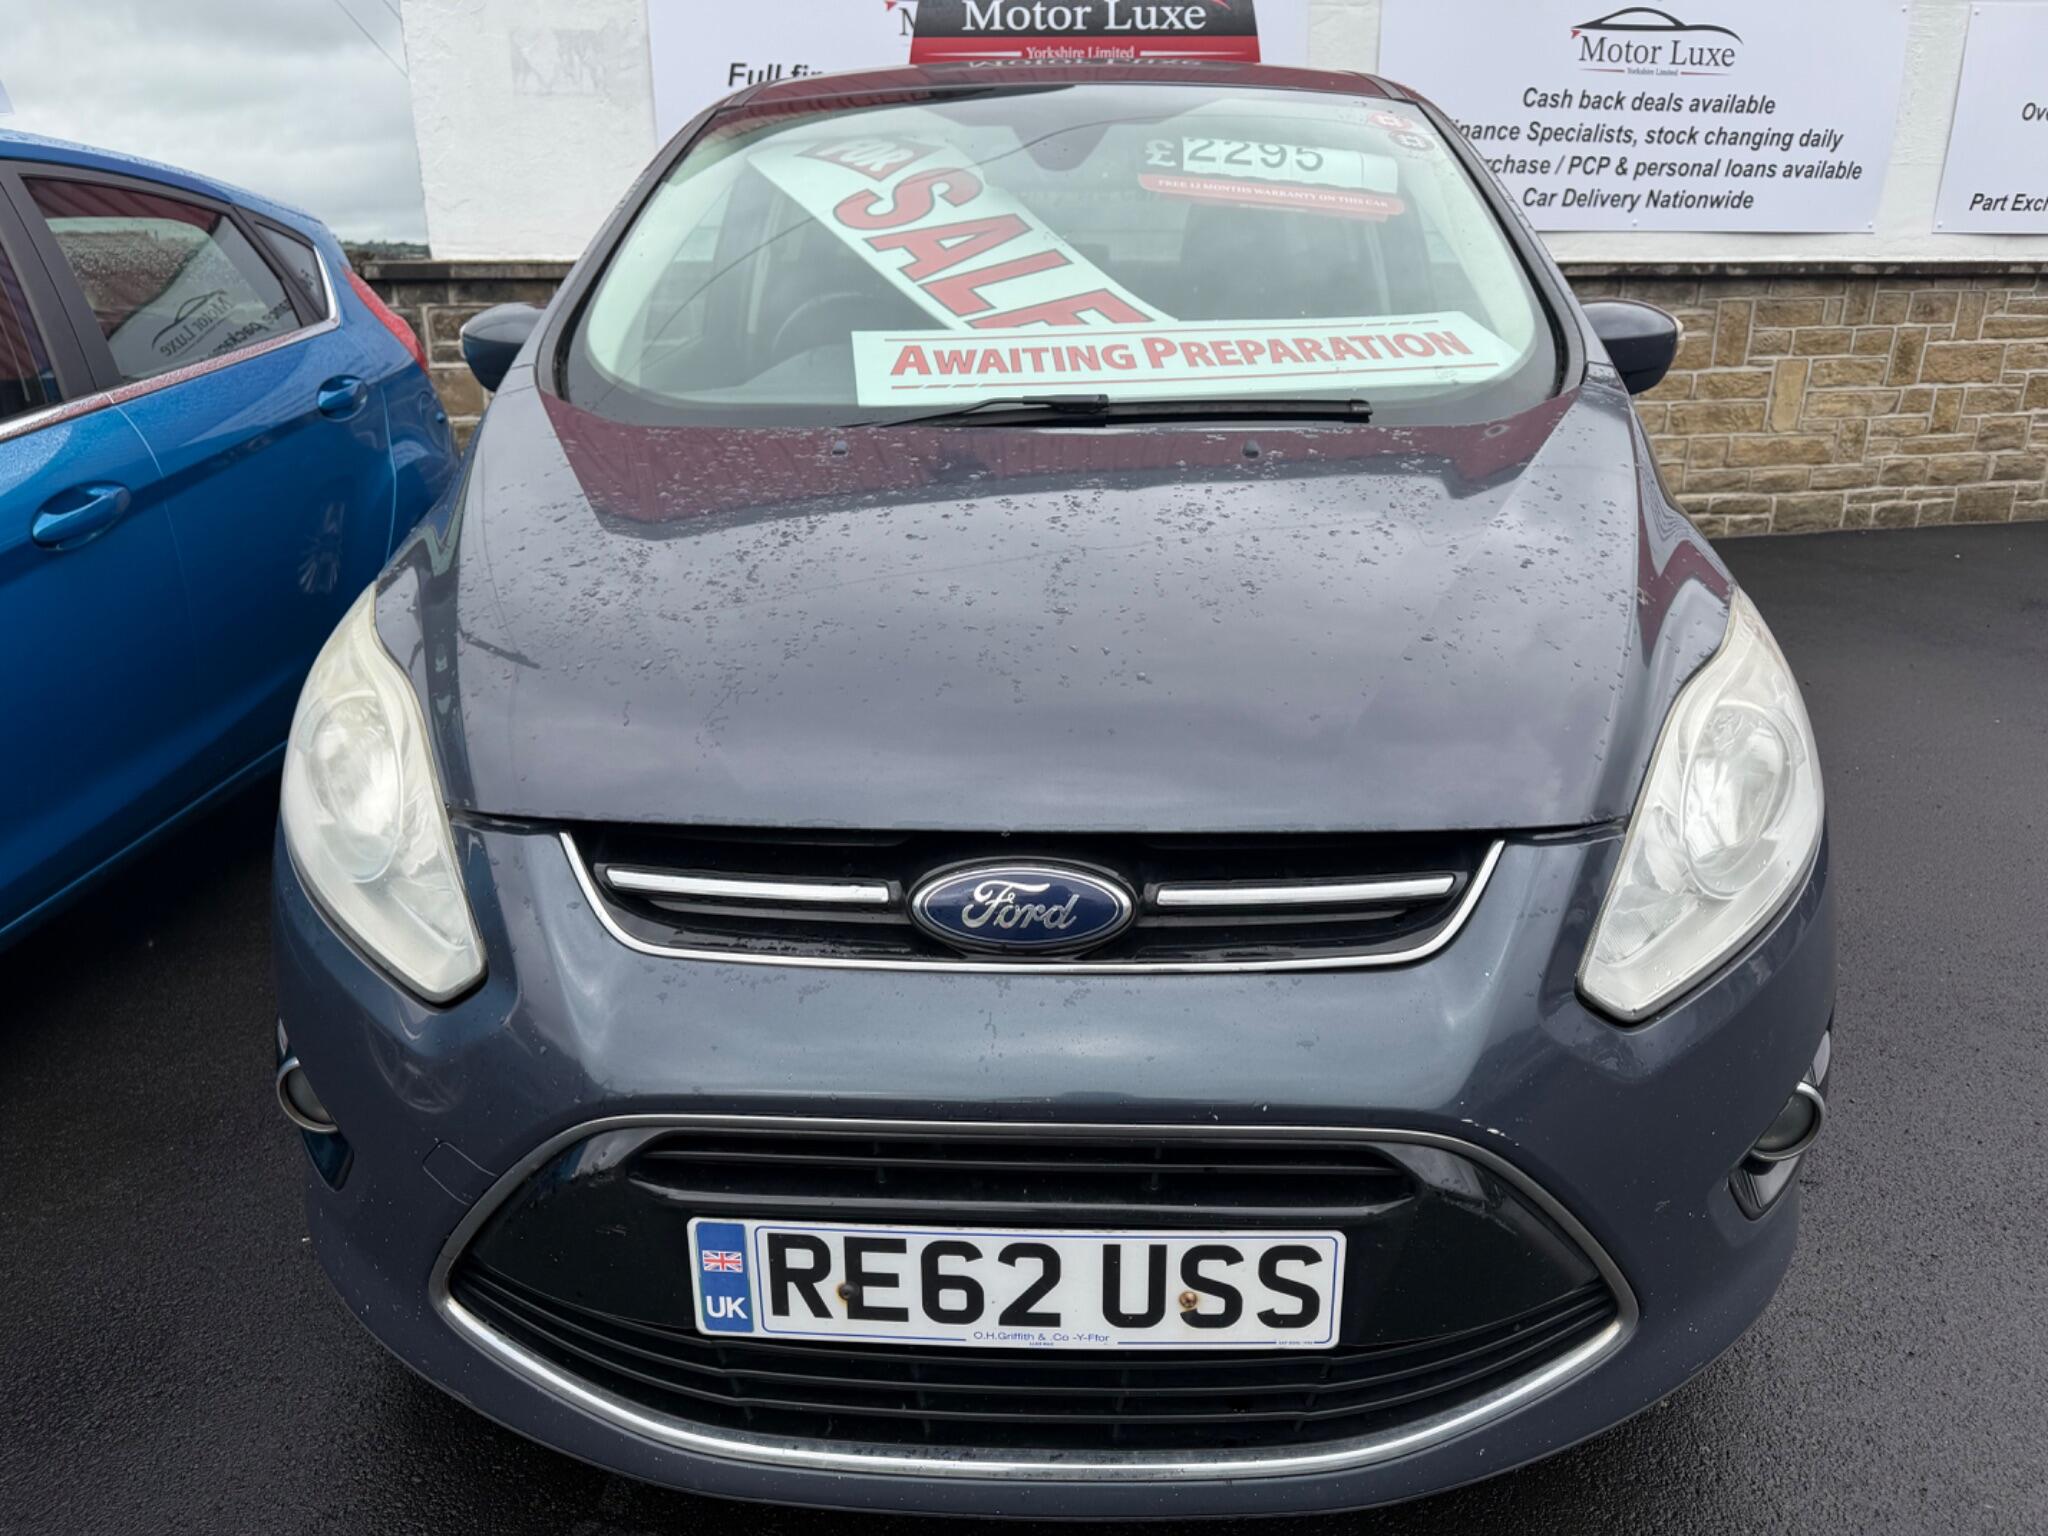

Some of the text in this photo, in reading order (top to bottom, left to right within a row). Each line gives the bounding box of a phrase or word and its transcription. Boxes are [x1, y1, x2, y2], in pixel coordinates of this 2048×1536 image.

[961, 0, 1207, 31] Motor Luxe
[1026, 46, 1135, 60] Yorkshire Limited
[1578, 35, 1736, 67] Motor Luxe
[1522, 87, 1775, 115] Cash back deals available
[1527, 121, 1638, 147] Specialists,
[1644, 126, 1700, 146] stock
[1704, 127, 1794, 151] changing
[1799, 128, 1844, 152] daily
[1554, 155, 1566, 175] /
[1568, 156, 1611, 176] PCP
[1615, 156, 1629, 177] &
[1633, 158, 1721, 181] personal
[1724, 159, 1777, 178] loans
[1782, 160, 1863, 180] available
[1253, 187, 1317, 200] WARRANTY
[1523, 187, 1754, 213] Car Delivery Nationwide
[1969, 193, 2008, 211] Part
[1141, 330, 1474, 369] PREPARATION
[961, 879, 1080, 929] Ford
[767, 1233, 1322, 1330] RE62 USS
[706, 1295, 748, 1320] UK
